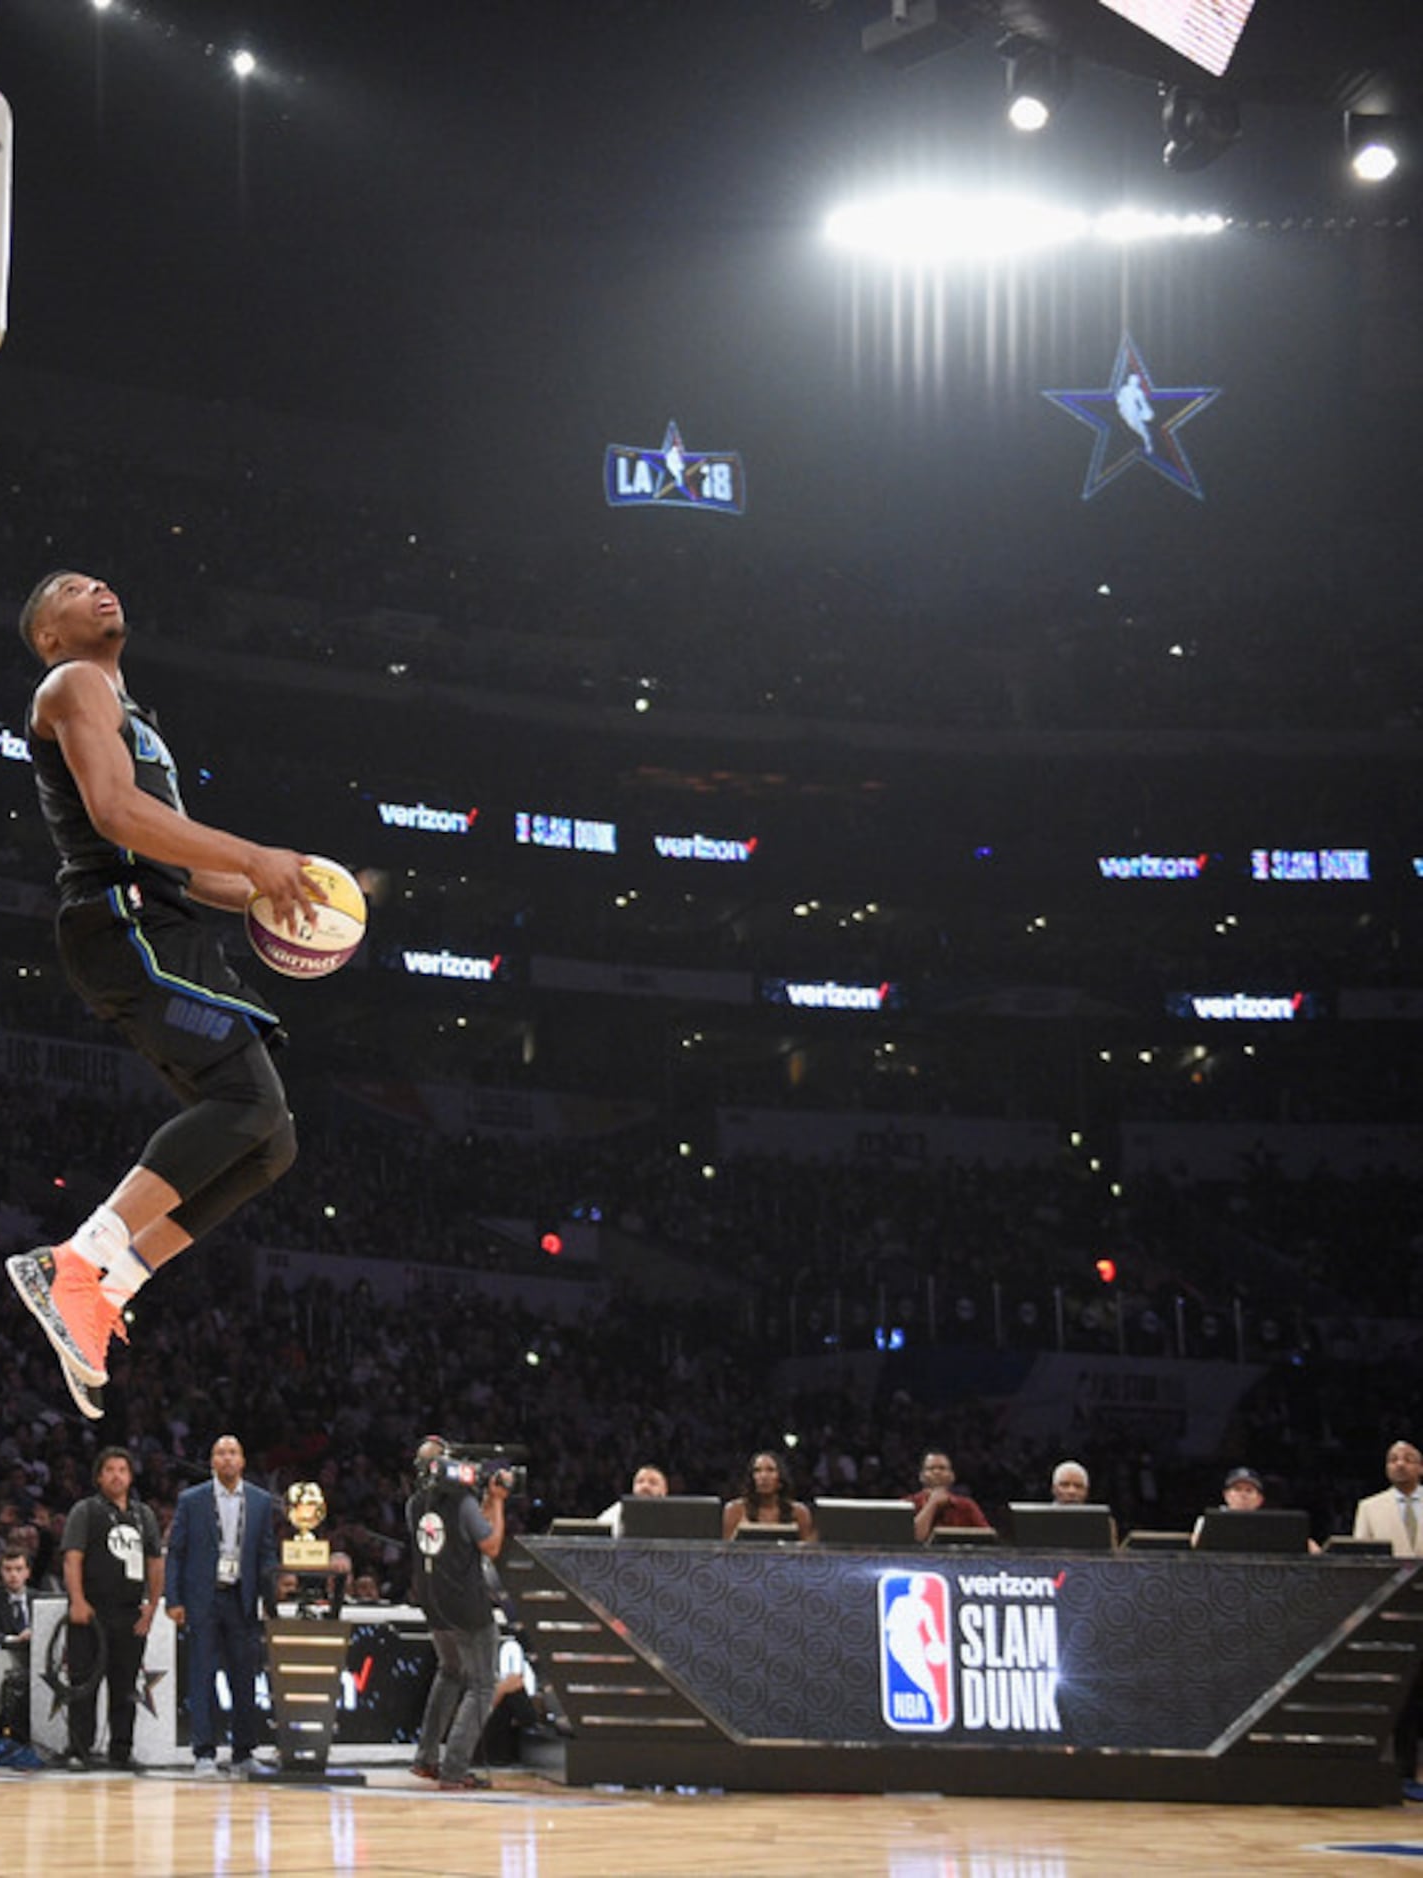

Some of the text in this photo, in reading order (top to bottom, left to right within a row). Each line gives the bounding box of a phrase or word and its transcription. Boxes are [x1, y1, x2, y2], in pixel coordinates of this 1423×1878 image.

[616, 456, 733, 501] LA 18
[378, 801, 469, 834] verizon
[654, 831, 750, 862] verizon
[1097, 852, 1200, 880] verizon
[402, 948, 493, 982] verizon
[786, 980, 881, 1011] verizon
[1191, 992, 1295, 1021] verizon
[958, 1571, 1055, 1598] verizon
[958, 1603, 1059, 1669] SLAM
[893, 1691, 928, 1720] NBA
[960, 1668, 1063, 1732] DUNK
